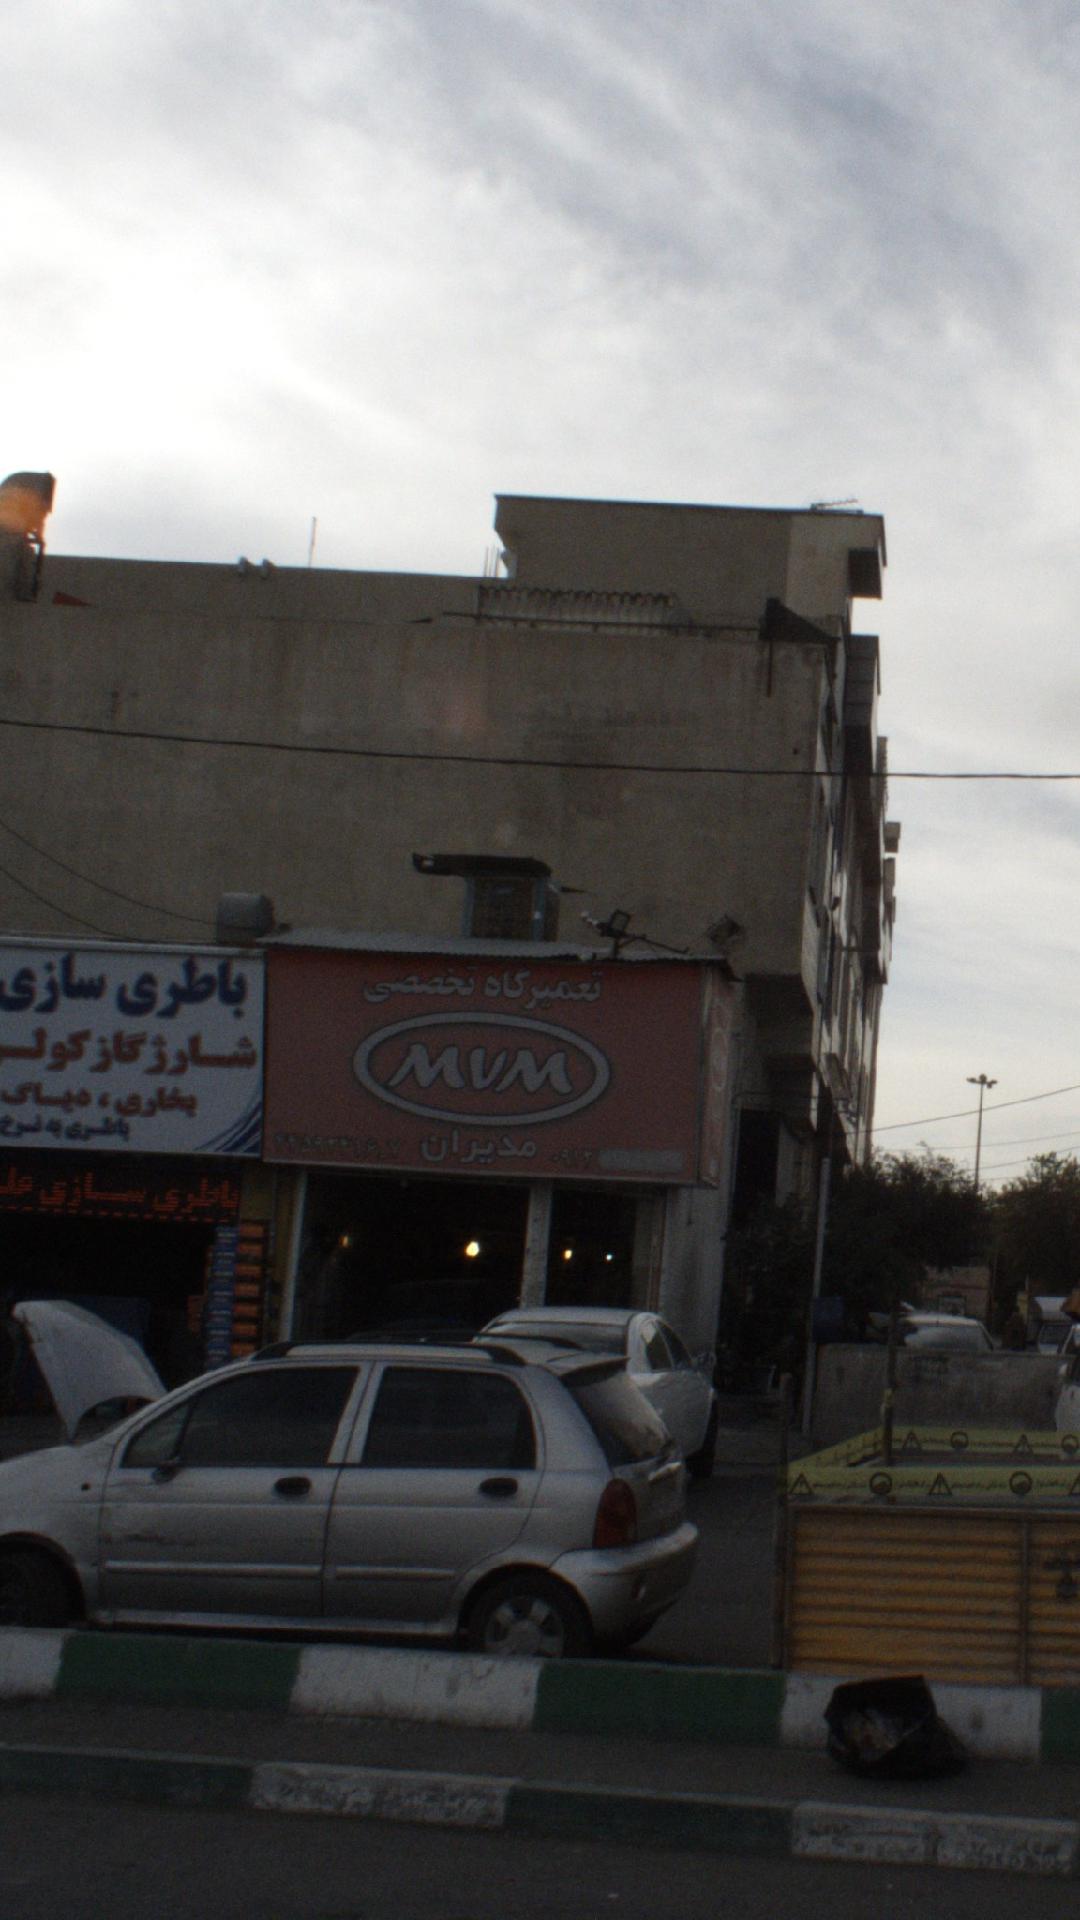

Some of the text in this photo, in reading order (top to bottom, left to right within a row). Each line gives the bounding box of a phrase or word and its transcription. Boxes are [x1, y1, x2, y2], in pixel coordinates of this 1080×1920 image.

[0, 952, 248, 1018] باطری سازی
[363, 966, 604, 1009] تعمیرگاه تخصصی
[0, 1027, 257, 1074] شارژ گاز کول
[389, 1043, 574, 1094] MVM
[420, 1129, 537, 1163] مدیران
